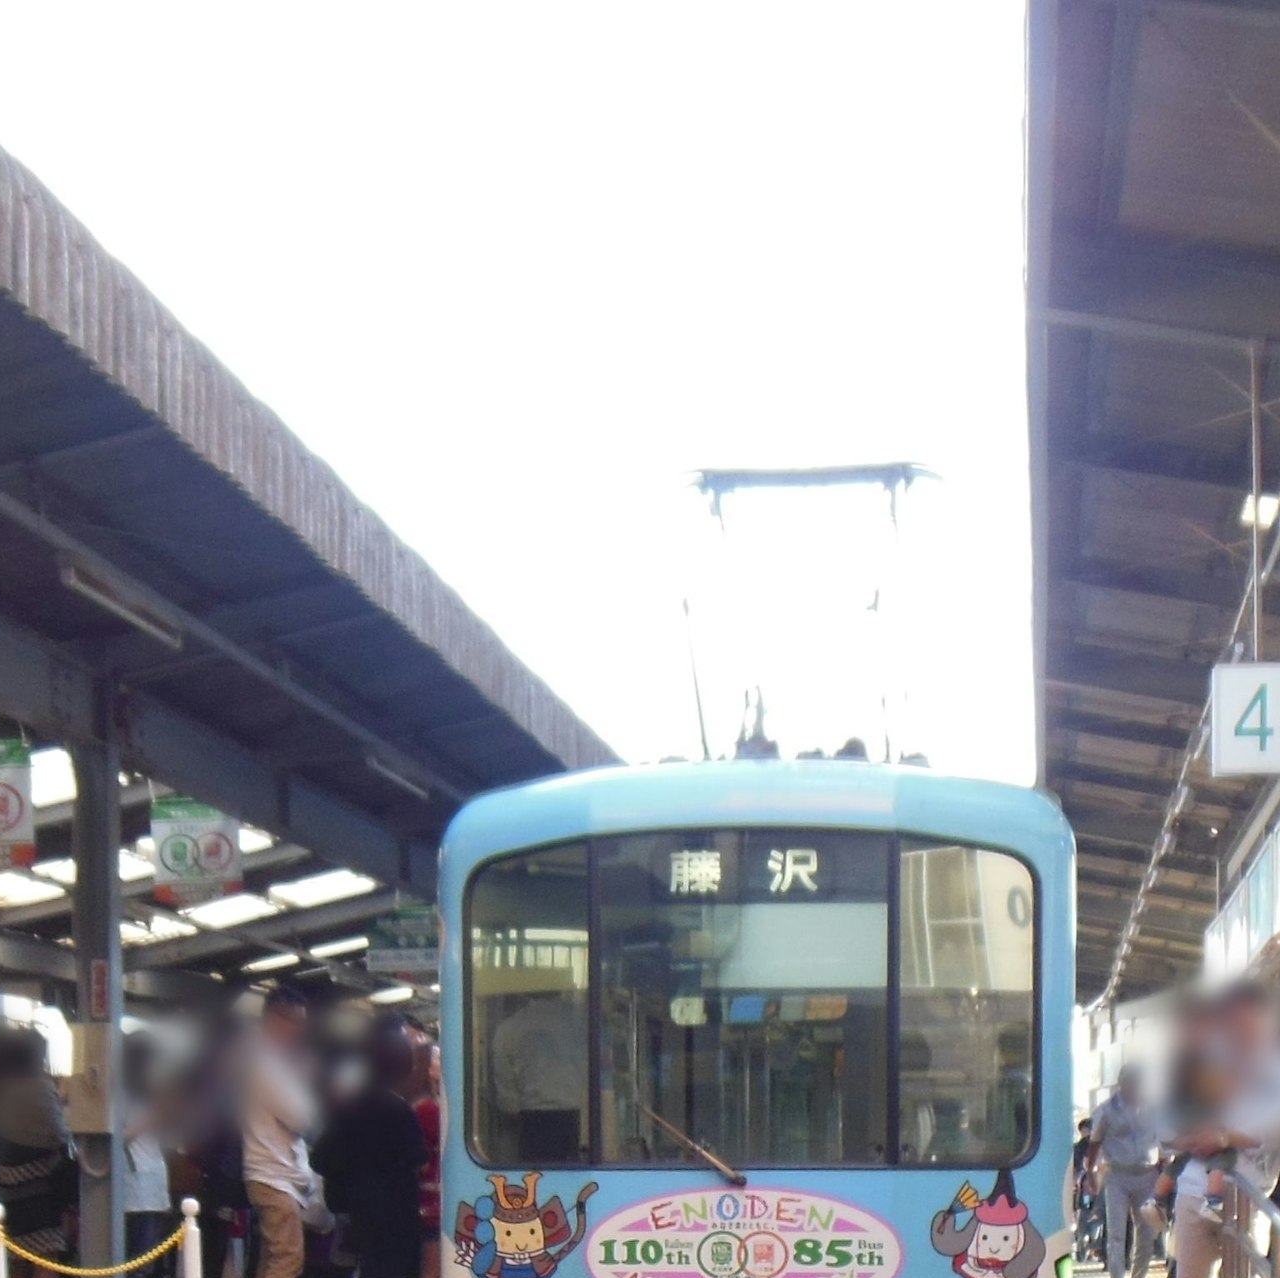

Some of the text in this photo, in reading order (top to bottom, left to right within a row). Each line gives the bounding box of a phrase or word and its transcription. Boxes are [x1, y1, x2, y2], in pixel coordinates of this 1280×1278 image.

[1234, 683, 1273, 751] 4
[669, 849, 819, 893] 藤沢
[650, 1193, 835, 1231] ENODEN
[858, 1239, 884, 1251] Bus
